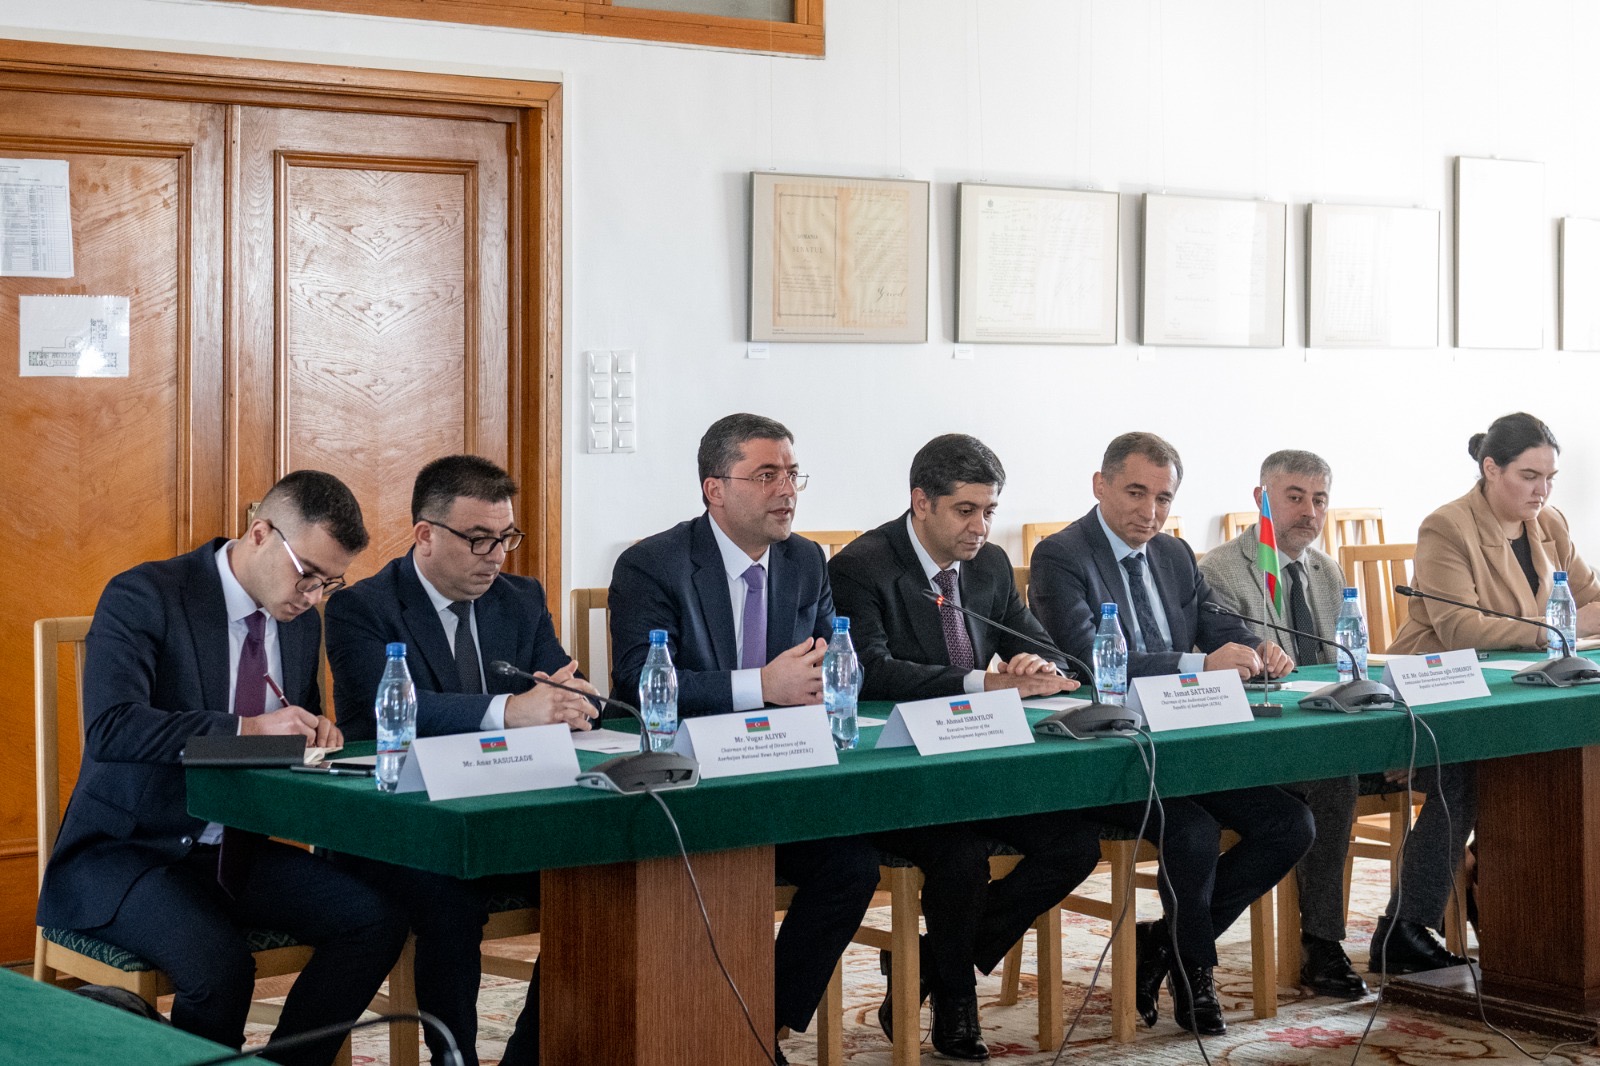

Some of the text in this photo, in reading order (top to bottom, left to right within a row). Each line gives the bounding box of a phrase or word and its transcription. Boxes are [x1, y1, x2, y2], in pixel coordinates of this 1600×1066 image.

[1190, 687, 1221, 696] SATTAROV
[964, 713, 994, 723] ISMAYILOV
[764, 732, 787, 741] ALIYEV
[462, 755, 534, 768] Mr. Anar RASULZADE
